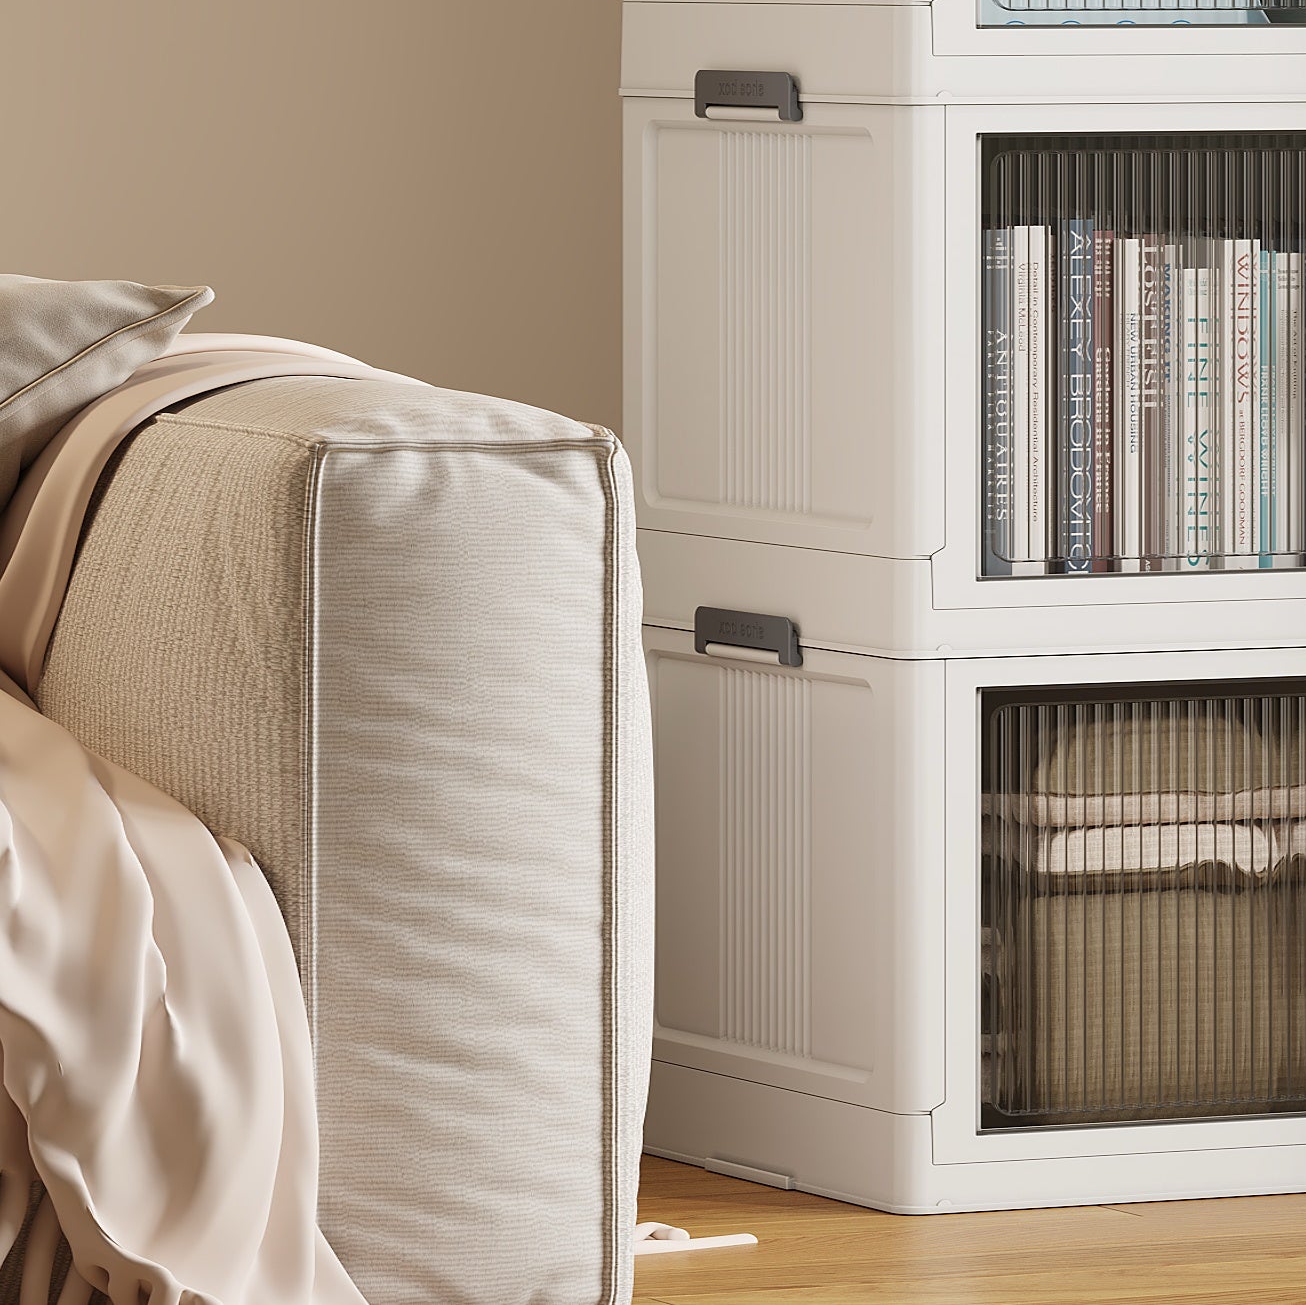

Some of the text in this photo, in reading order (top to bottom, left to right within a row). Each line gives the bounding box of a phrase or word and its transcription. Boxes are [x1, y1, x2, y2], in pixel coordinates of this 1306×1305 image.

[1018, 263, 1026, 352] Virginia McLeod
[1032, 296, 1039, 307] in
[1236, 253, 1253, 404] WINDOWS
[1031, 310, 1039, 388] Contemporary
[1188, 318, 1208, 408] FINE
[1070, 230, 1091, 574] ALEXEY BRODOVITC
[1239, 410, 1245, 418] at
[1188, 430, 1208, 567] WINES
